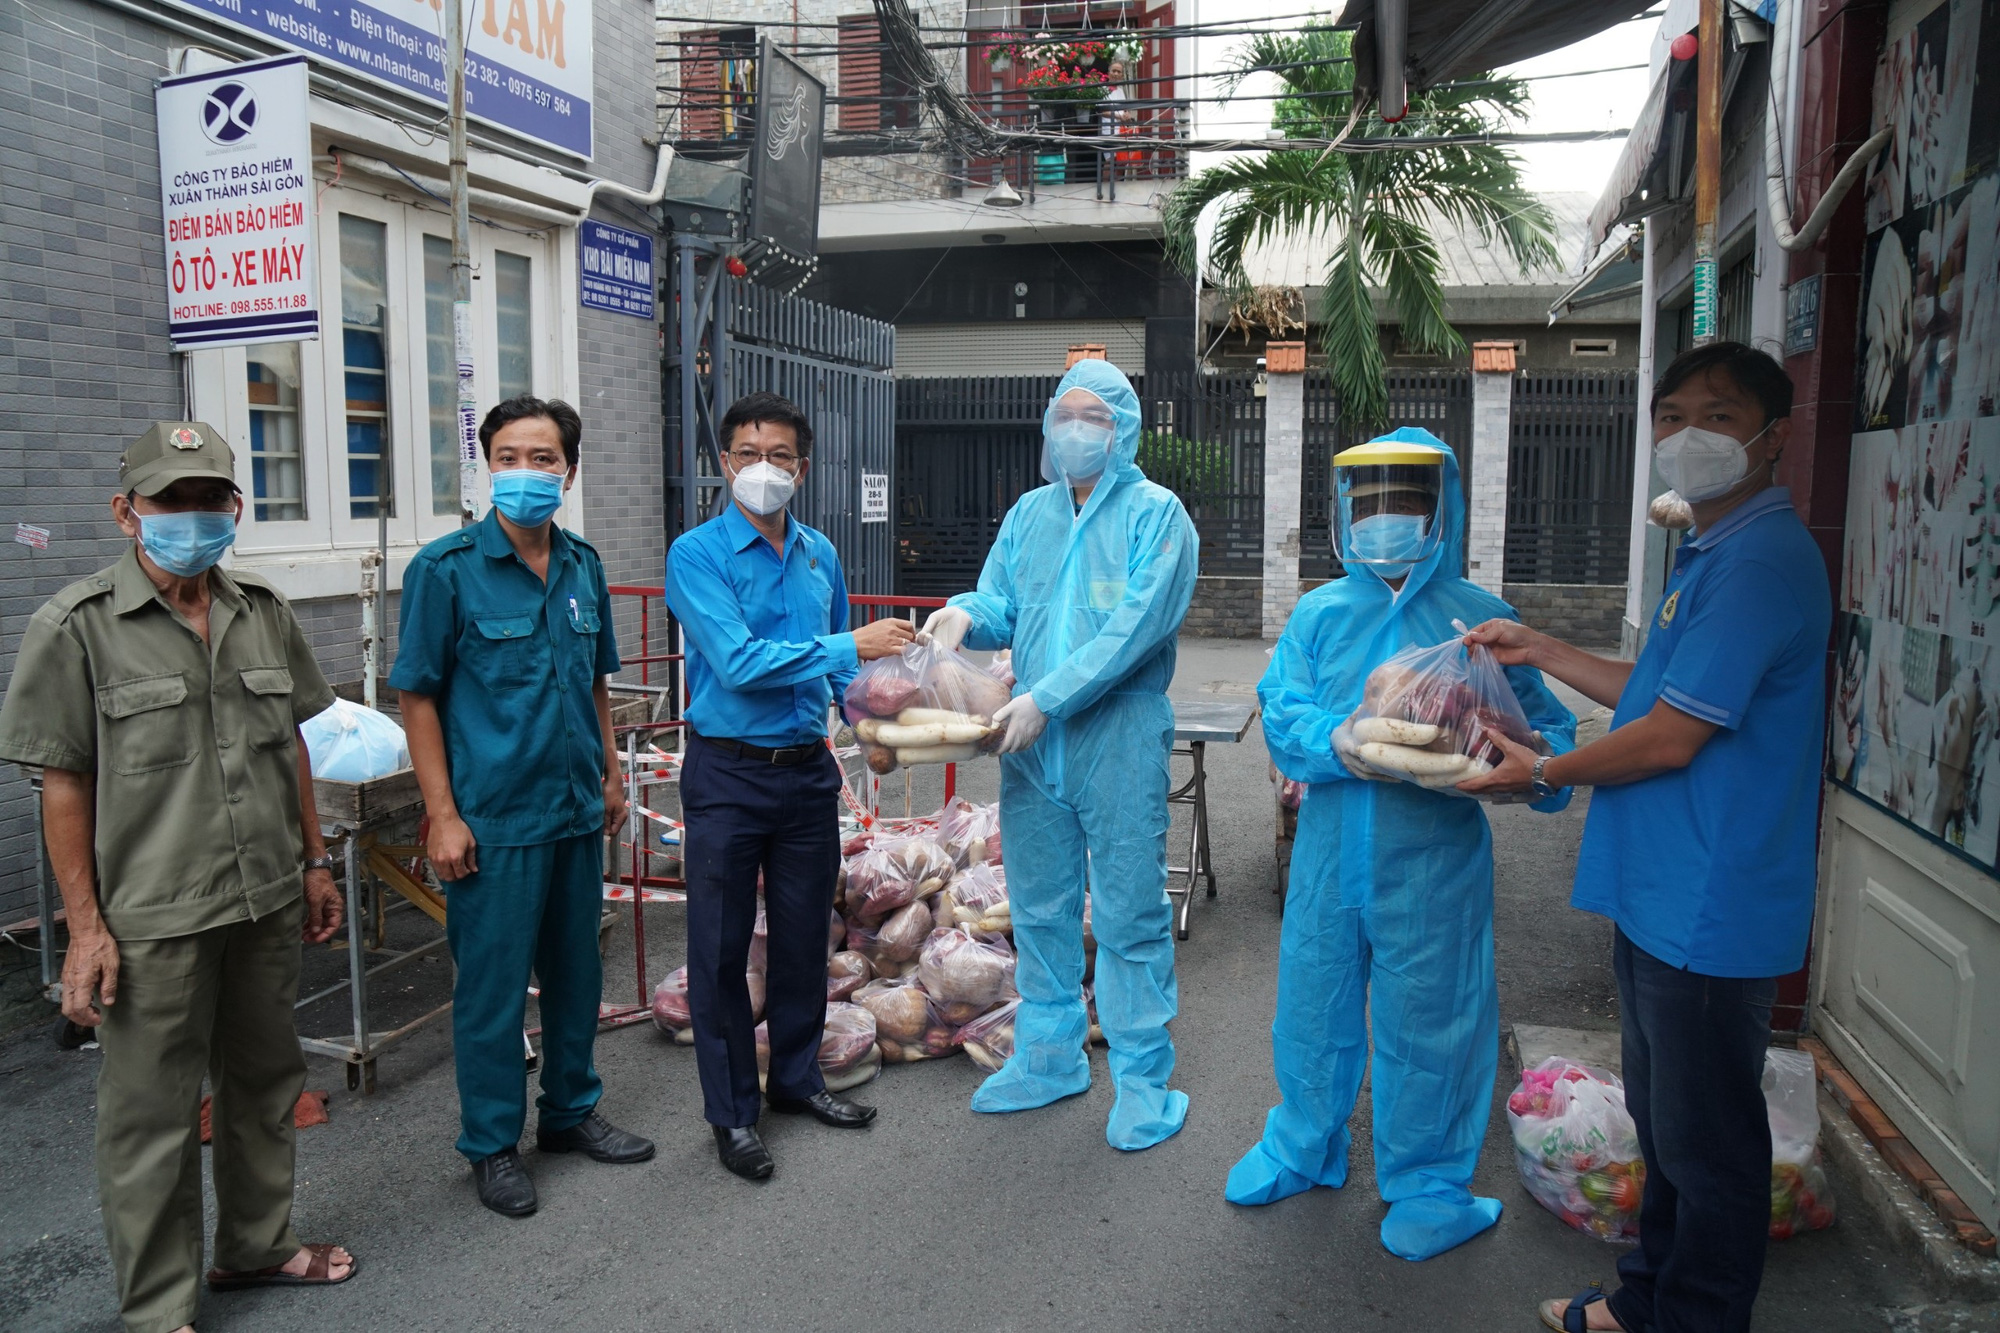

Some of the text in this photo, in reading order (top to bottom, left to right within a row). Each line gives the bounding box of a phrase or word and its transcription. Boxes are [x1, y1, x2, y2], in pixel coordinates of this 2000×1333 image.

[265, 9, 332, 50] website:
[350, 8, 382, 39] Điện
[386, 25, 422, 56] thoại:
[480, 64, 499, 88] 382
[508, 77, 532, 102] 0975
[534, 88, 551, 109] 597
[554, 96, 571, 117] 564
[169, 173, 303, 206] XUÂN THÀNH SÀI GÒN
[174, 156, 293, 188] CÔNG TY BẢO HIỂM
[169, 198, 303, 242] ĐIỂM BÁN BẢO HIỂM
[595, 226, 610, 241] CÔNG
[611, 231, 617, 243] TY
[172, 250, 185, 294] Ô
[190, 247, 216, 292] TÔ
[232, 250, 257, 287] XE
[262, 237, 304, 284] MÁY
[584, 245, 599, 273] KHO
[634, 259, 651, 285] NAM
[174, 294, 307, 319] HOTLINE: 098.555.11.88
[864, 476, 887, 489] SALON
